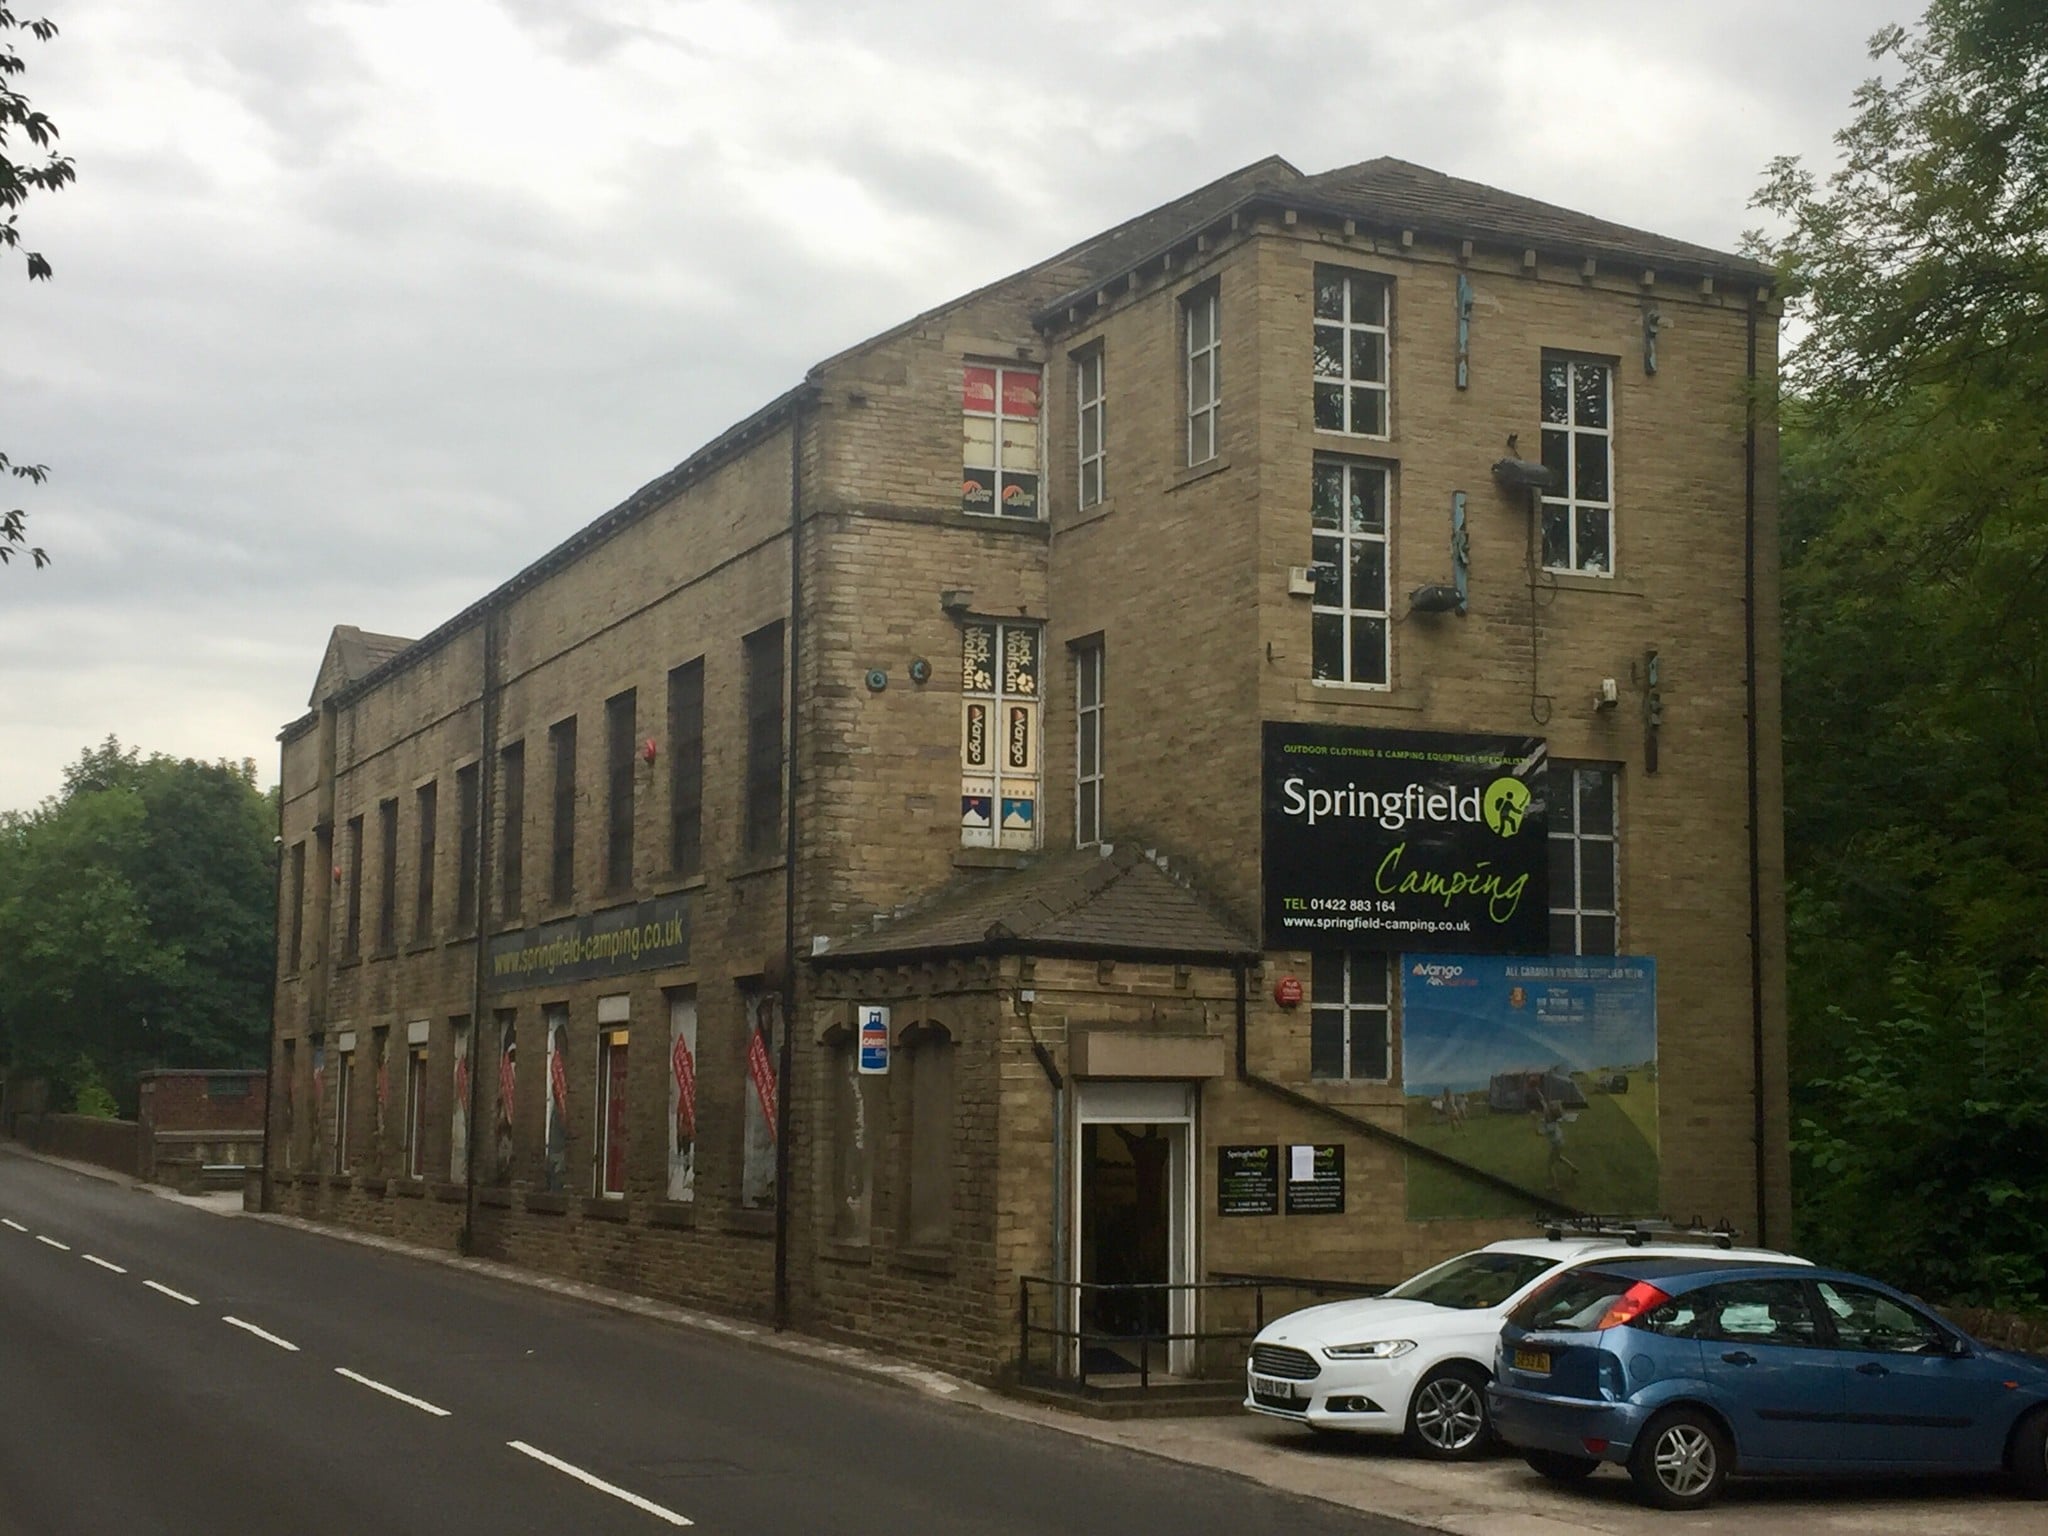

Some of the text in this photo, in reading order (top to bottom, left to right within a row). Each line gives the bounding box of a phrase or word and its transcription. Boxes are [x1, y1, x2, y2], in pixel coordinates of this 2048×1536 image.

[963, 627, 977, 689] Wolfskin
[1006, 630, 1020, 692] Wolfskin
[969, 715, 983, 763] Vango
[1011, 718, 1025, 765] Vango
[1283, 744, 1328, 754] OUTDOOR
[1329, 746, 1375, 758] CLOTHING
[1376, 749, 1383, 758] &
[1385, 750, 1424, 761] CAMPING
[1427, 752, 1476, 763] EQUIPMENT
[1283, 778, 1481, 830] Springfield
[1283, 898, 1396, 912] TEL 01422 883 164
[1375, 842, 1529, 923] Camping
[493, 910, 683, 977] www.springfield-camping.co.uk
[1283, 916, 1471, 933] www.springfield-camping.co.uk
[1417, 963, 1463, 979] Vango
